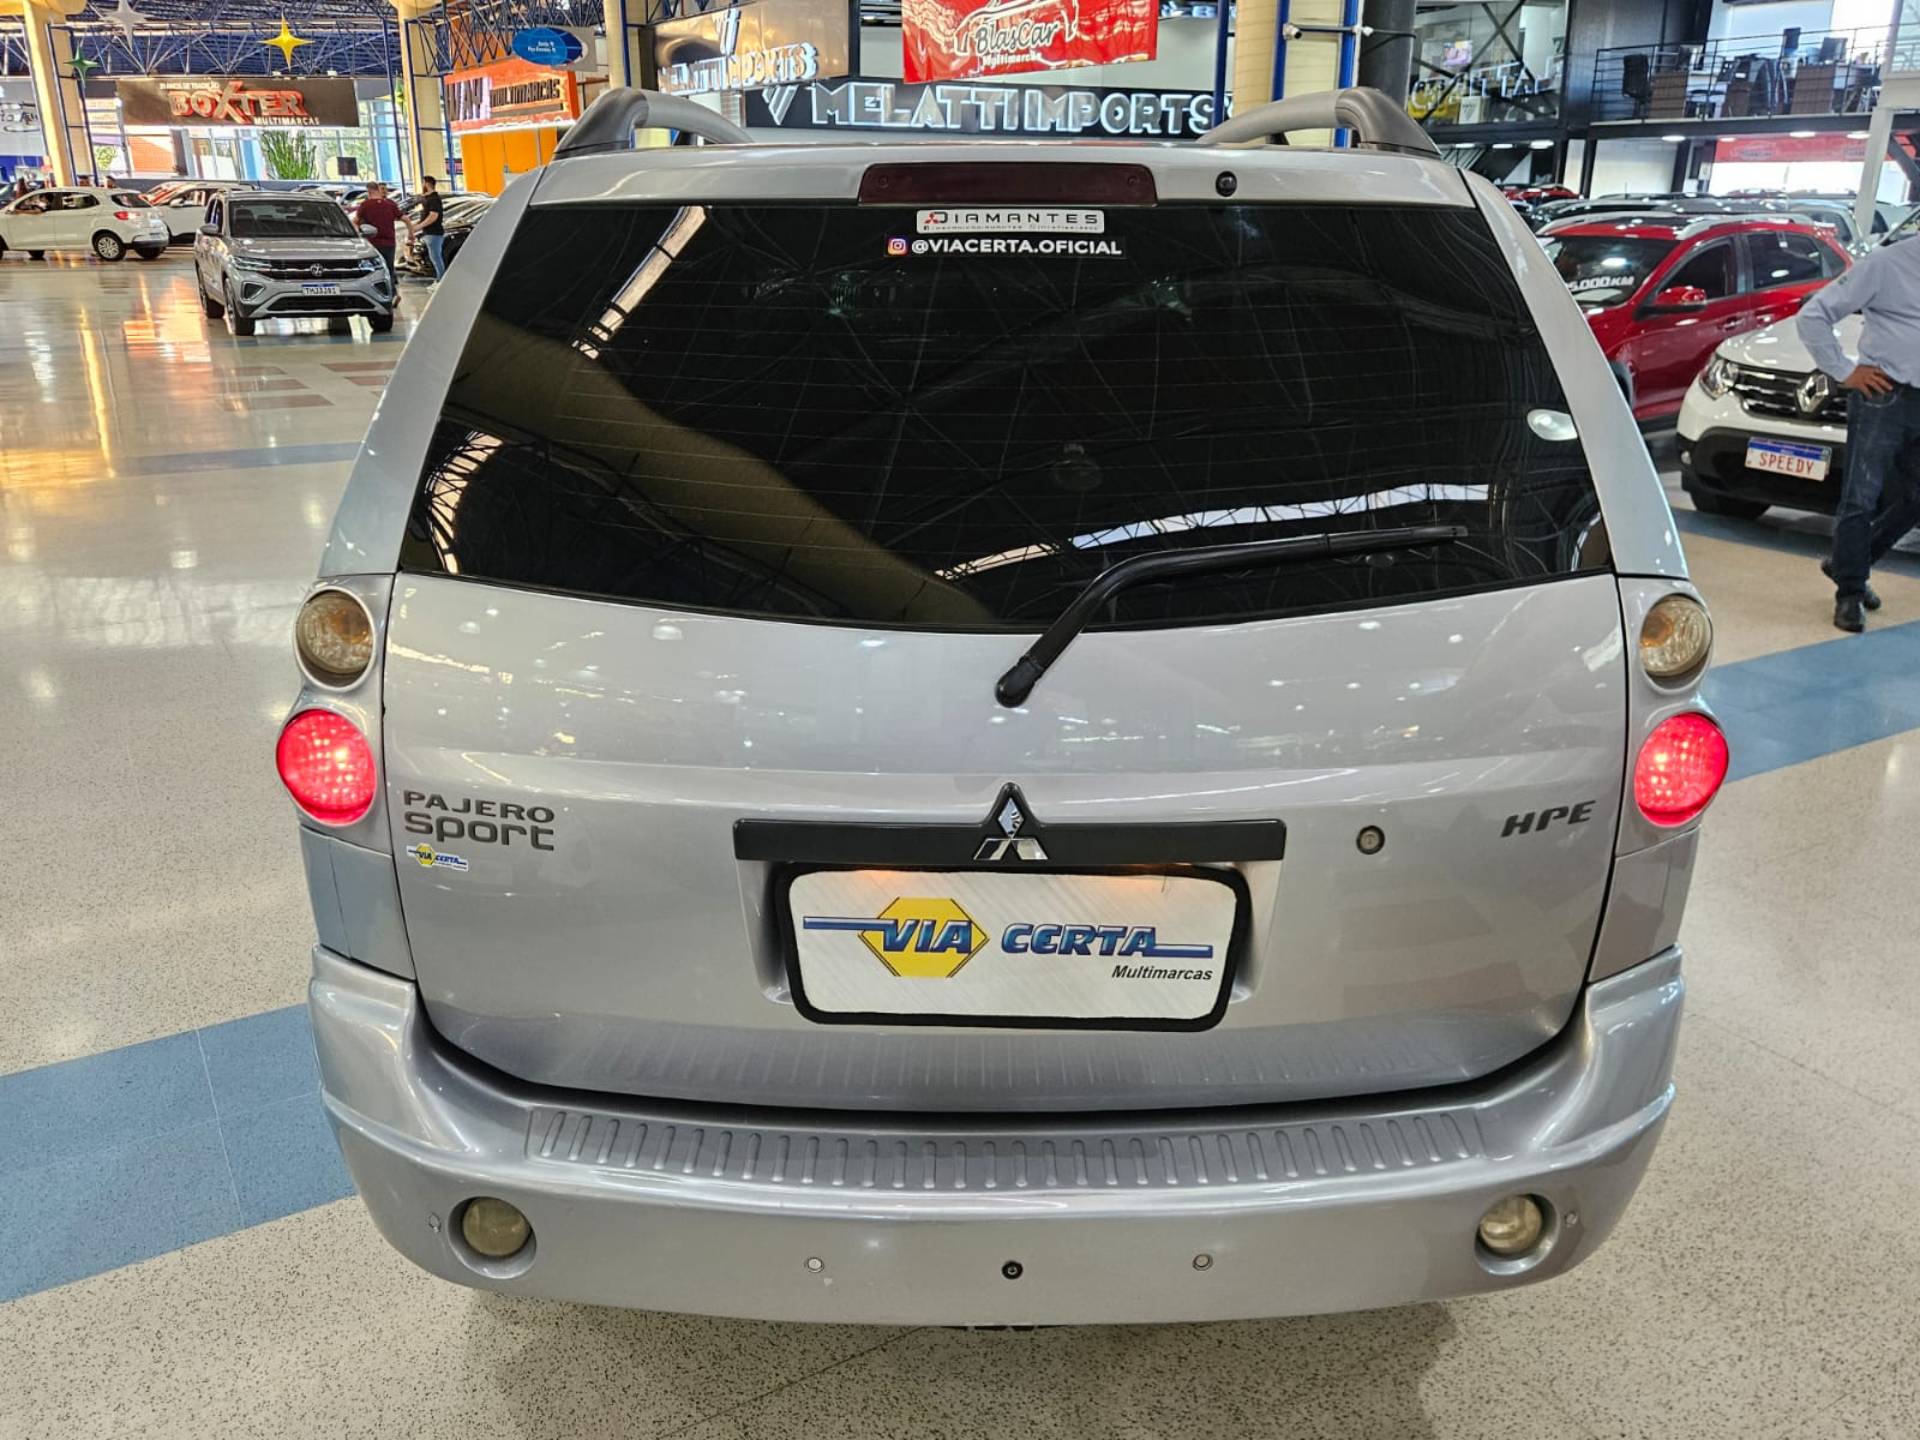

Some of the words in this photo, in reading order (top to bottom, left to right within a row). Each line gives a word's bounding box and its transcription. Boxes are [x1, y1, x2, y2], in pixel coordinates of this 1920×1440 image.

[974, 18, 1058, 56] BlasCar
[168, 80, 307, 124] BOXTER
[812, 82, 1018, 131] MELATTI
[1024, 89, 1215, 134] IMPORTS
[254, 117, 320, 126] MULTIMARCAS
[911, 239, 1122, 255] @VIACERTA.OFICIAL
[1759, 452, 1814, 474] SPEEDY
[403, 790, 555, 823] PAJERO
[1500, 799, 1597, 838] HPE
[882, 919, 973, 954] VIA
[1001, 921, 1158, 957] CERTA
[1111, 964, 1213, 981] Multimarcas
